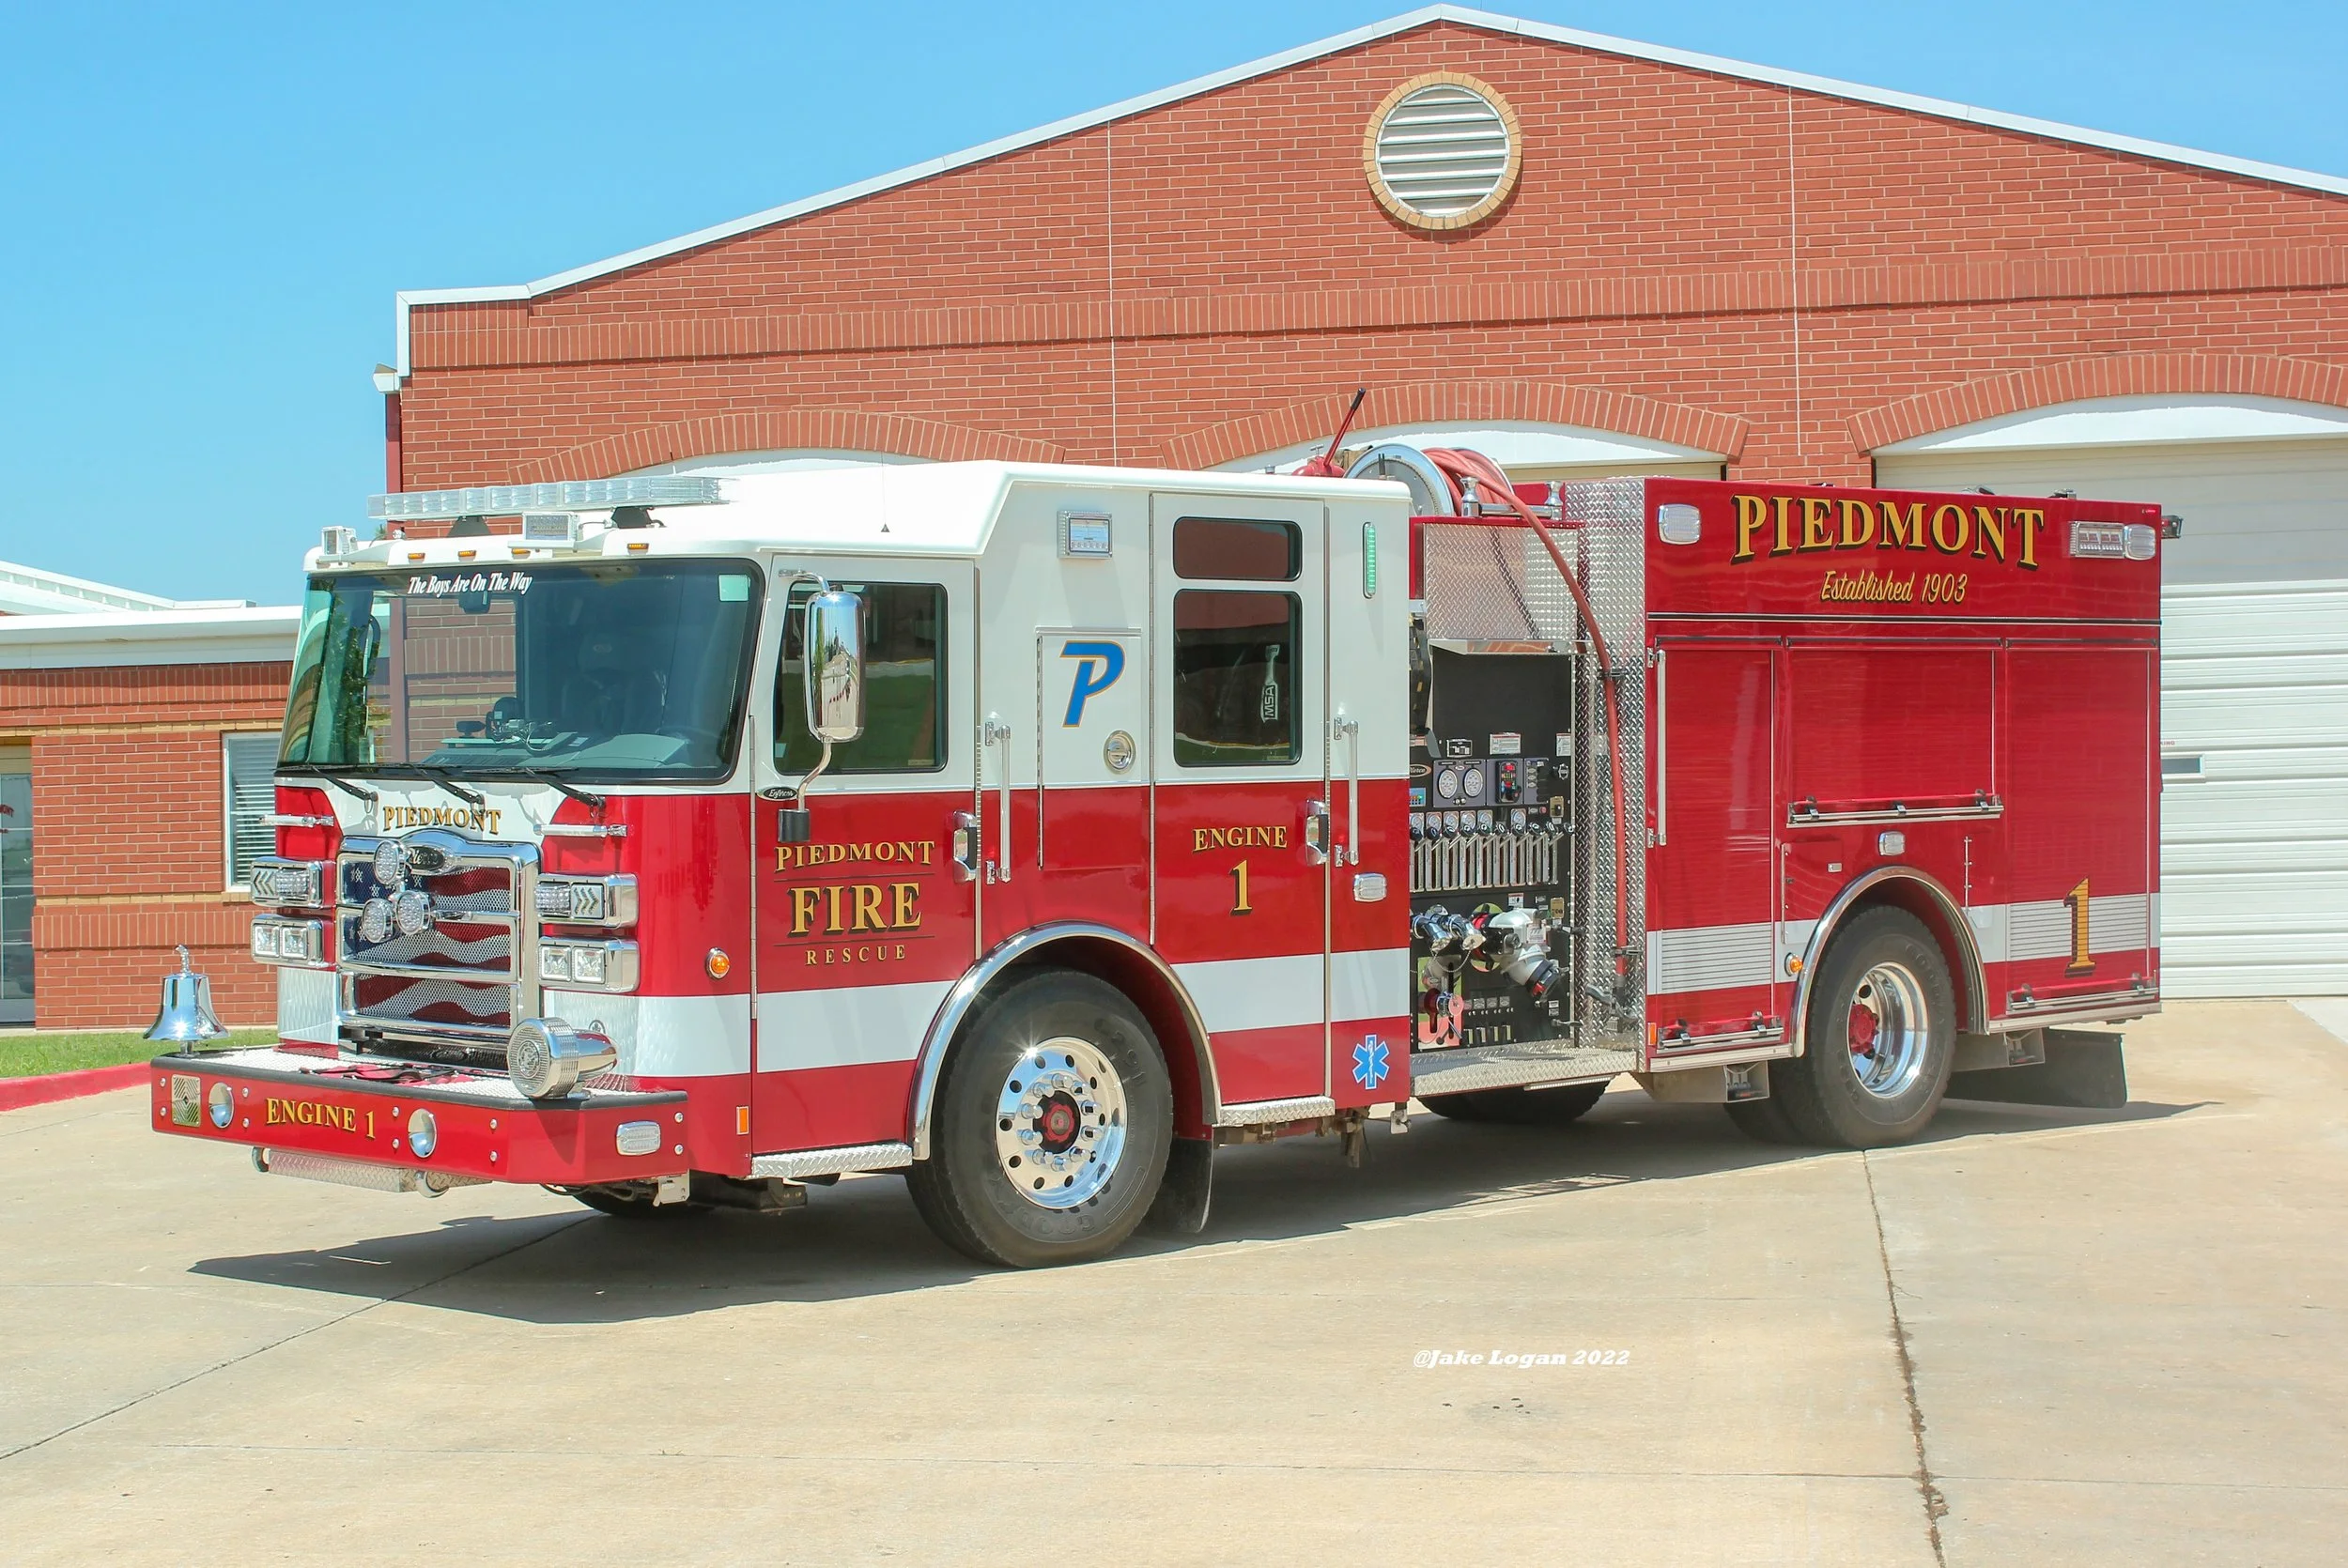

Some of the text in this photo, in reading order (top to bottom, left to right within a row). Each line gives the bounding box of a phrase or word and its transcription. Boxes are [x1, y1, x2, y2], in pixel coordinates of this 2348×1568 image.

[1732, 495, 2045, 570] PIEDMONT
[408, 572, 533, 598] The Boys Are On The Way
[1821, 569, 1969, 603] Established 1903
[1059, 639, 1126, 728] P
[1264, 685, 1275, 717] MSA
[382, 806, 502, 835] PIEDMONT
[774, 840, 935, 872] PIEDMONT
[1192, 826, 1288, 853] ENGINE
[1229, 859, 1253, 915] 1
[787, 883, 922, 938] FIRE
[2063, 876, 2096, 977] 1
[805, 945, 905, 966] RESCUE
[266, 1098, 376, 1140] ENGINE 1
